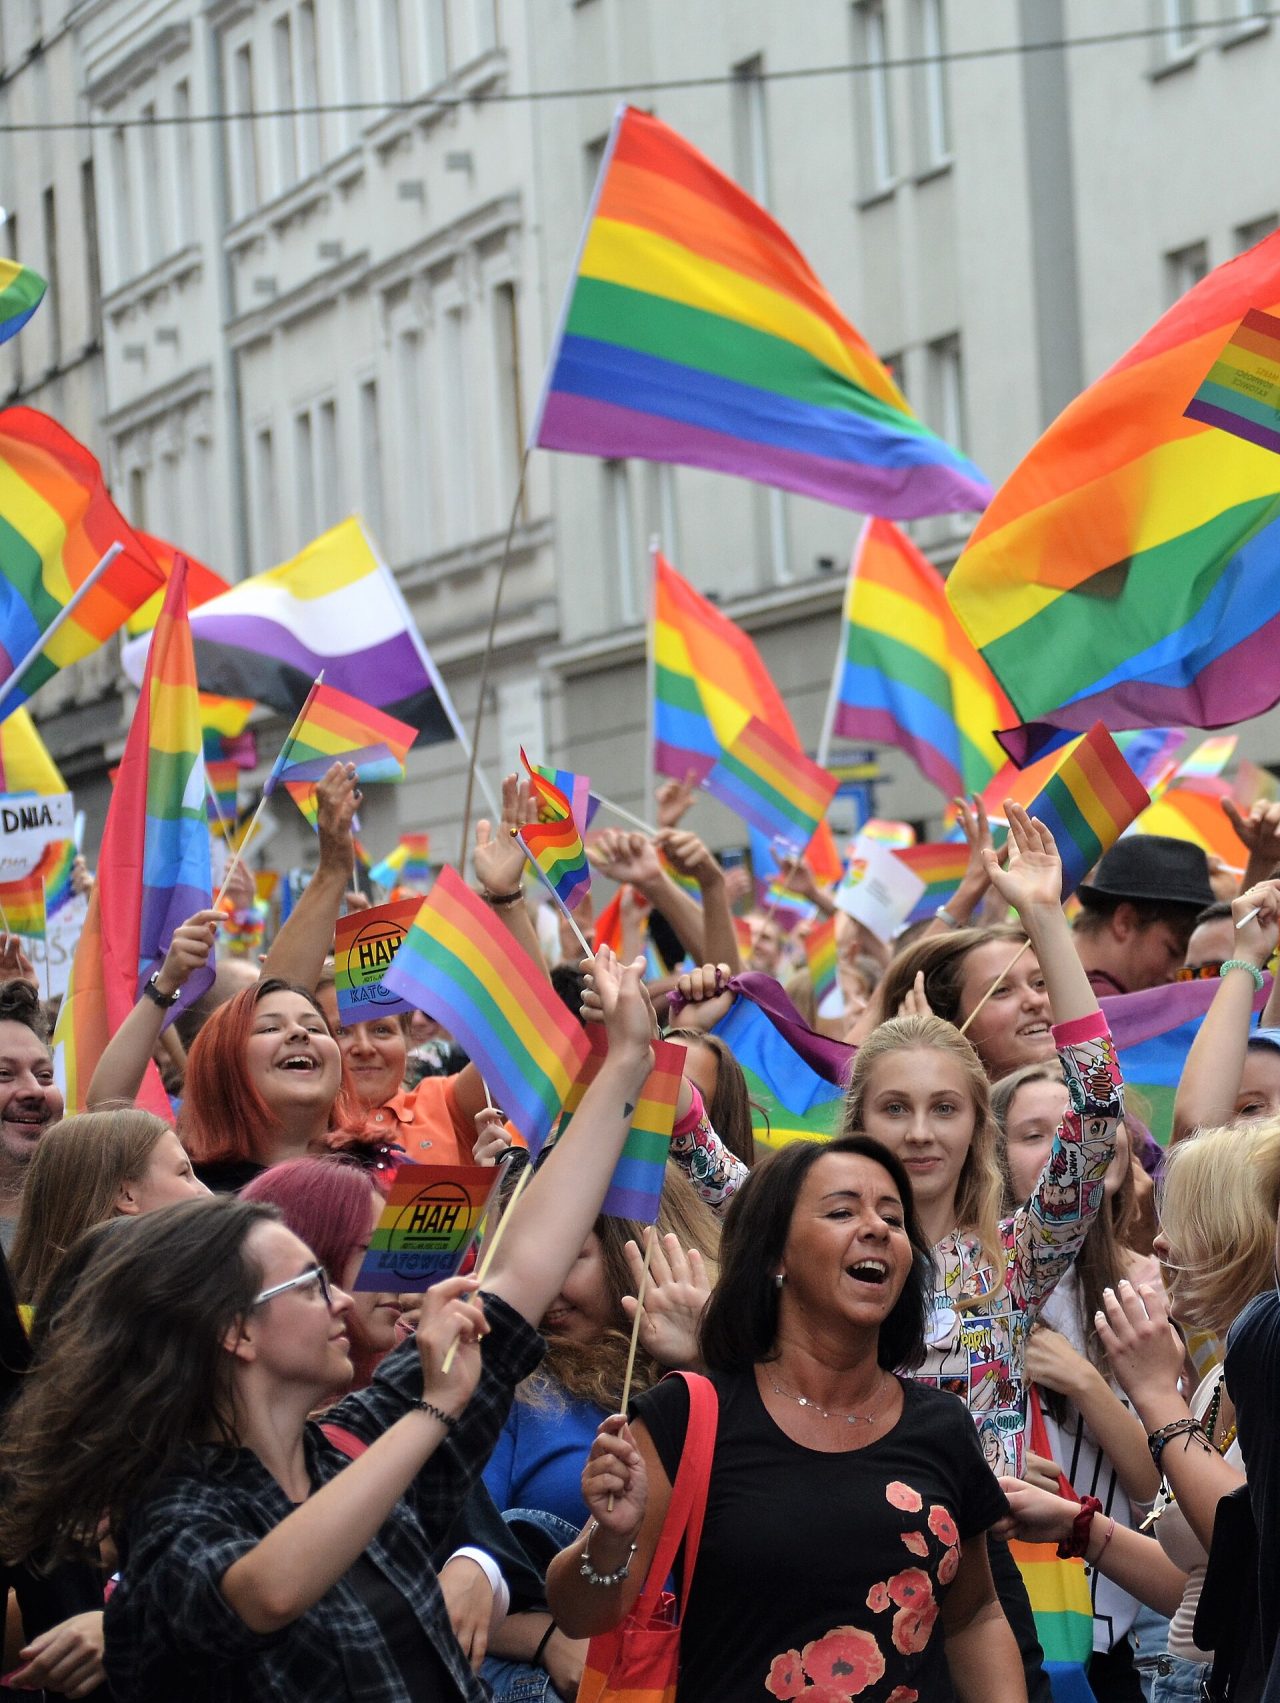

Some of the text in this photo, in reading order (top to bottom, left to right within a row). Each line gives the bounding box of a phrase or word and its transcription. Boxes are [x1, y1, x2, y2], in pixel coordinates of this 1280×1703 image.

[358, 935, 402, 969] HAH
[350, 983, 390, 1003] KATO
[407, 1204, 461, 1234] HAH
